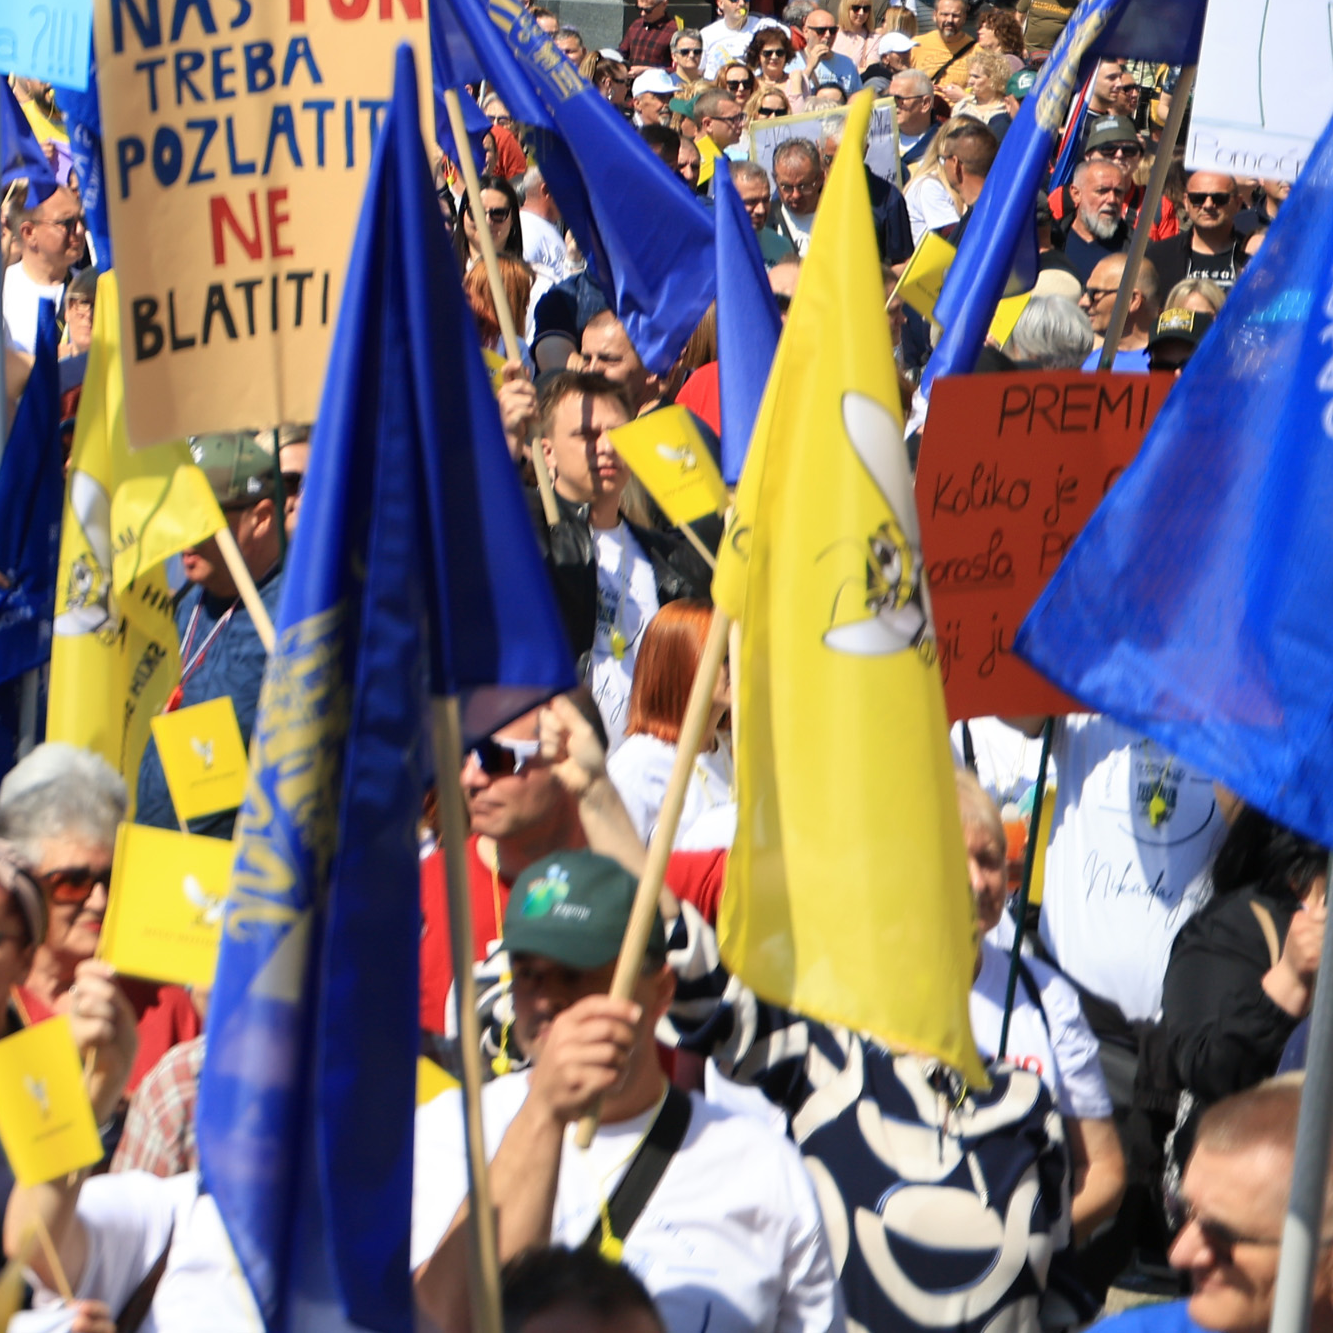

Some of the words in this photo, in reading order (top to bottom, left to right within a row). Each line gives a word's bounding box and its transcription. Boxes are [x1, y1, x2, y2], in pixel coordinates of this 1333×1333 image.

[134, 35, 324, 114] TREBA
[209, 186, 296, 268] NE
[133, 269, 331, 362] BLATITI
[931, 461, 1032, 518] Koliko
[1043, 464, 1079, 527] je
